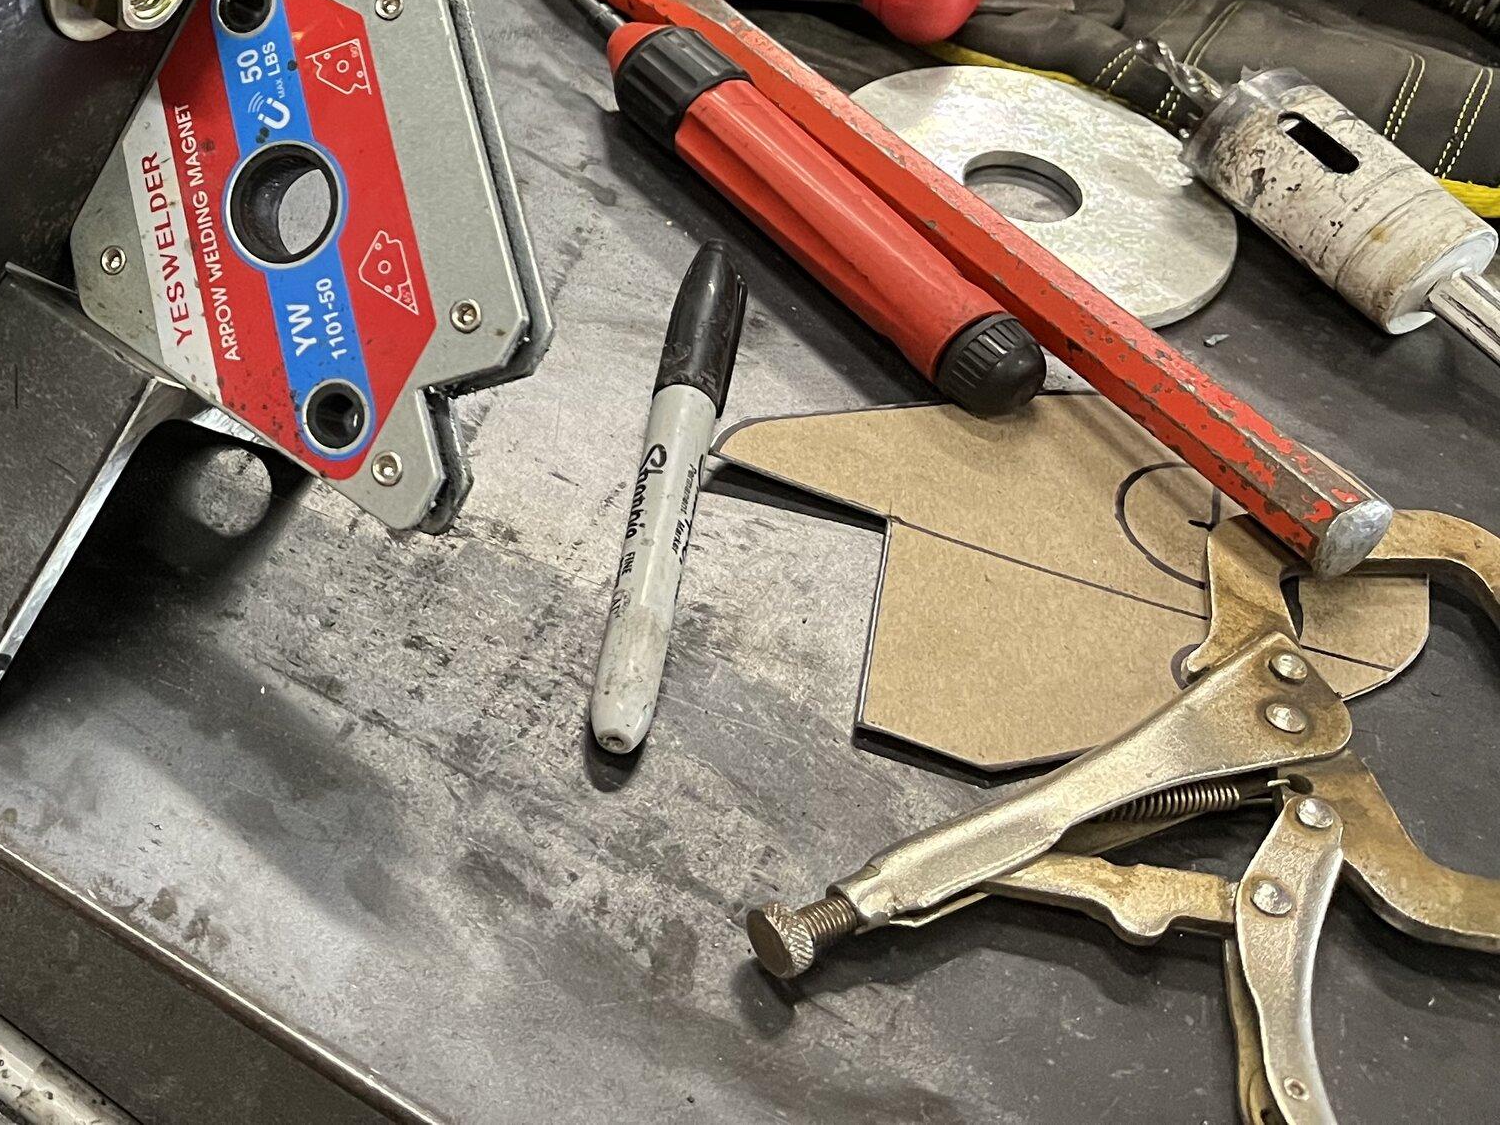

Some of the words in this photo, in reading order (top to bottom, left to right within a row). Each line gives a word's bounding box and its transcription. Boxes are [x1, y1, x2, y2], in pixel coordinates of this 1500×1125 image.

[236, 49, 263, 84] 50
[262, 41, 281, 77] LBS
[174, 103, 205, 188] MAGNET
[141, 151, 193, 347] YESWELDER
[192, 190, 224, 283] WELDING
[286, 303, 318, 357] YW
[315, 277, 348, 360] 1101-50
[680, 463, 698, 515] Permanent
[621, 551, 636, 576] FINE
[671, 519, 686, 555] Marker
